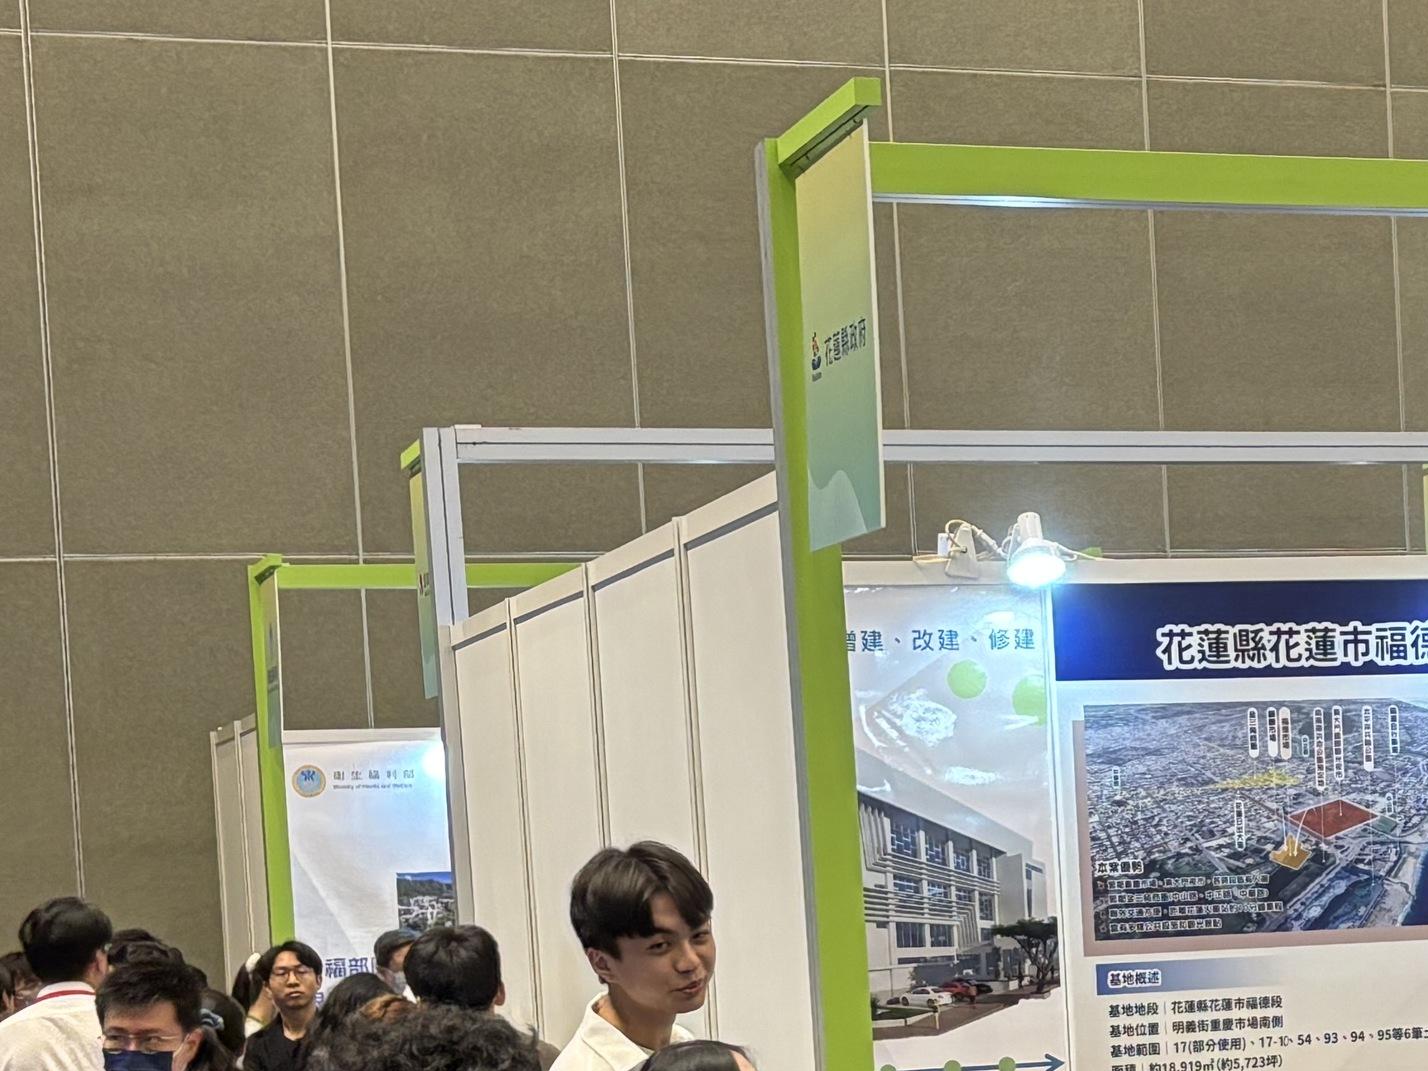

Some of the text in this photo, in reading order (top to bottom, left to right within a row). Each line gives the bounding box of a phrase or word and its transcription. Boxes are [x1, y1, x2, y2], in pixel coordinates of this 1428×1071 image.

[824, 317, 867, 367] 花蓮縣政府
[325, 957, 375, 978] 福部
[1109, 970, 1161, 987] 基地概述
[1108, 995, 1283, 1018] 基地地段 花蓮縣花蓮市福德段
[1109, 1015, 1284, 1038] 基地位置 明義街重慶市場南側
[1110, 1042, 1160, 1058] 基地範圍
